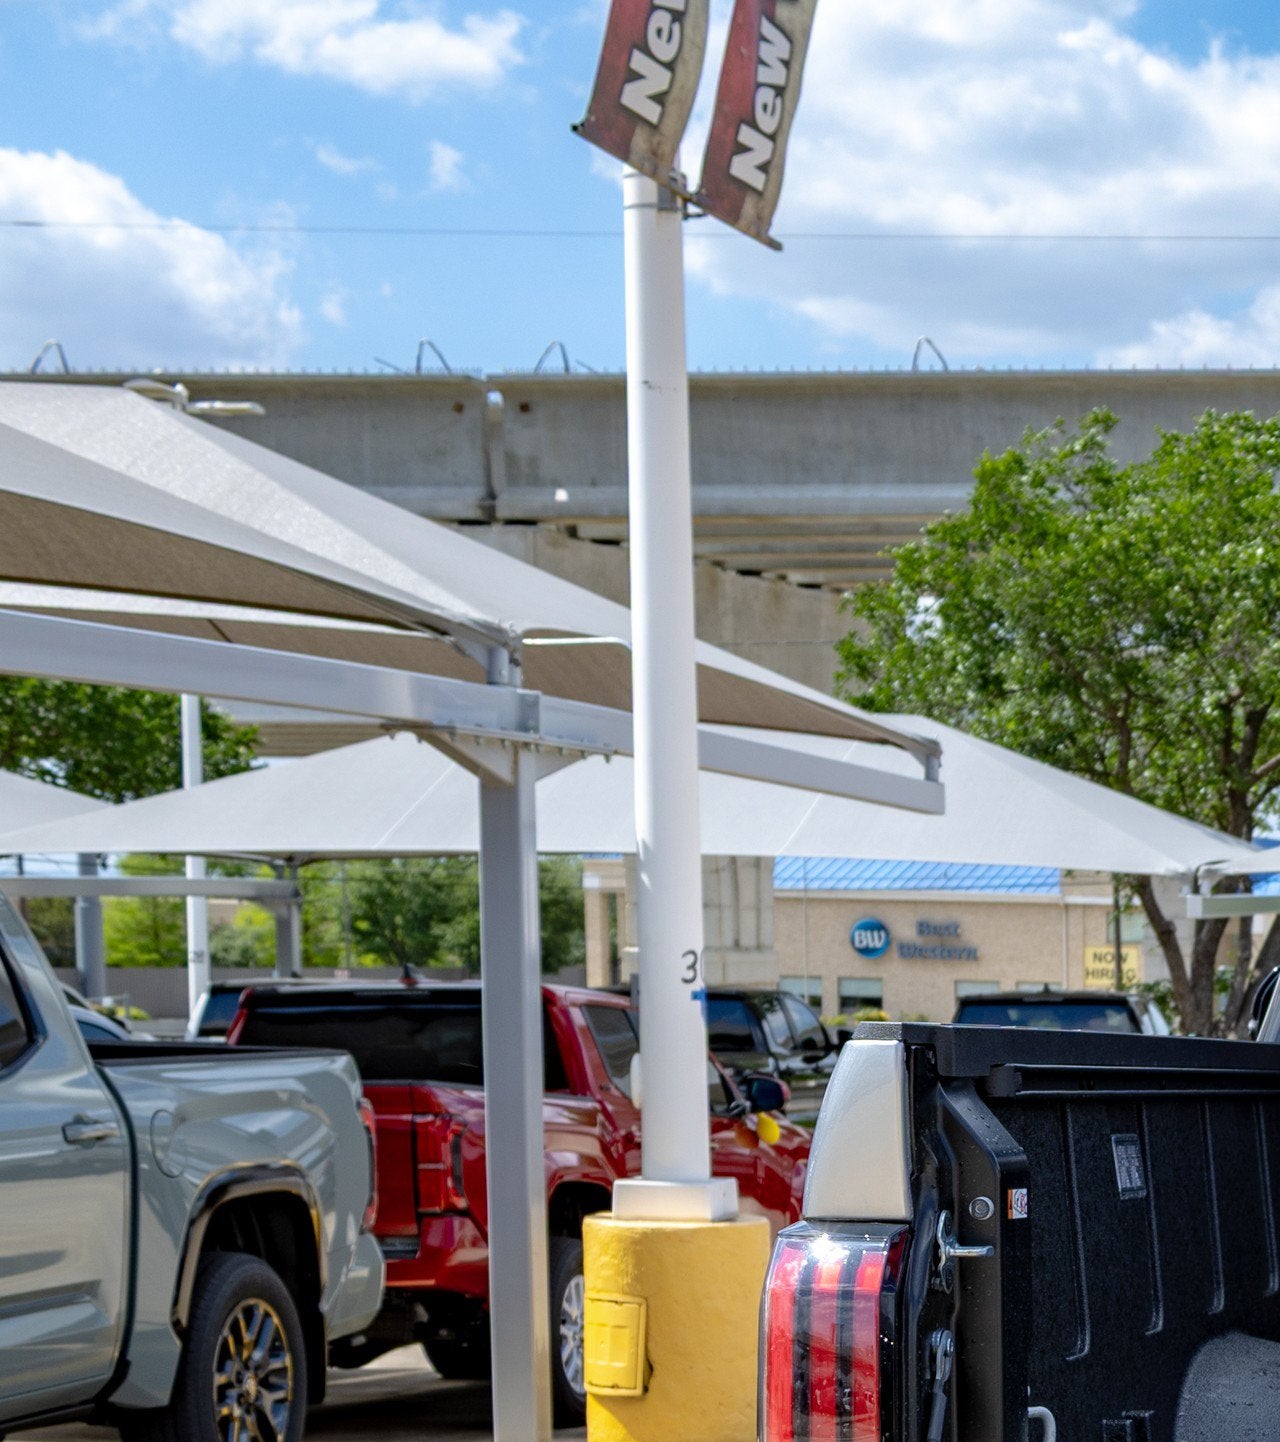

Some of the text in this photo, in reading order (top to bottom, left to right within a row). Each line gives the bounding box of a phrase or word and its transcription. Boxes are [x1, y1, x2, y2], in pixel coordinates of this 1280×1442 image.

[620, 0, 687, 126] Ne
[729, 14, 792, 192] New
[916, 920, 960, 936] Best
[854, 929, 886, 948] BW
[898, 942, 978, 961] Western
